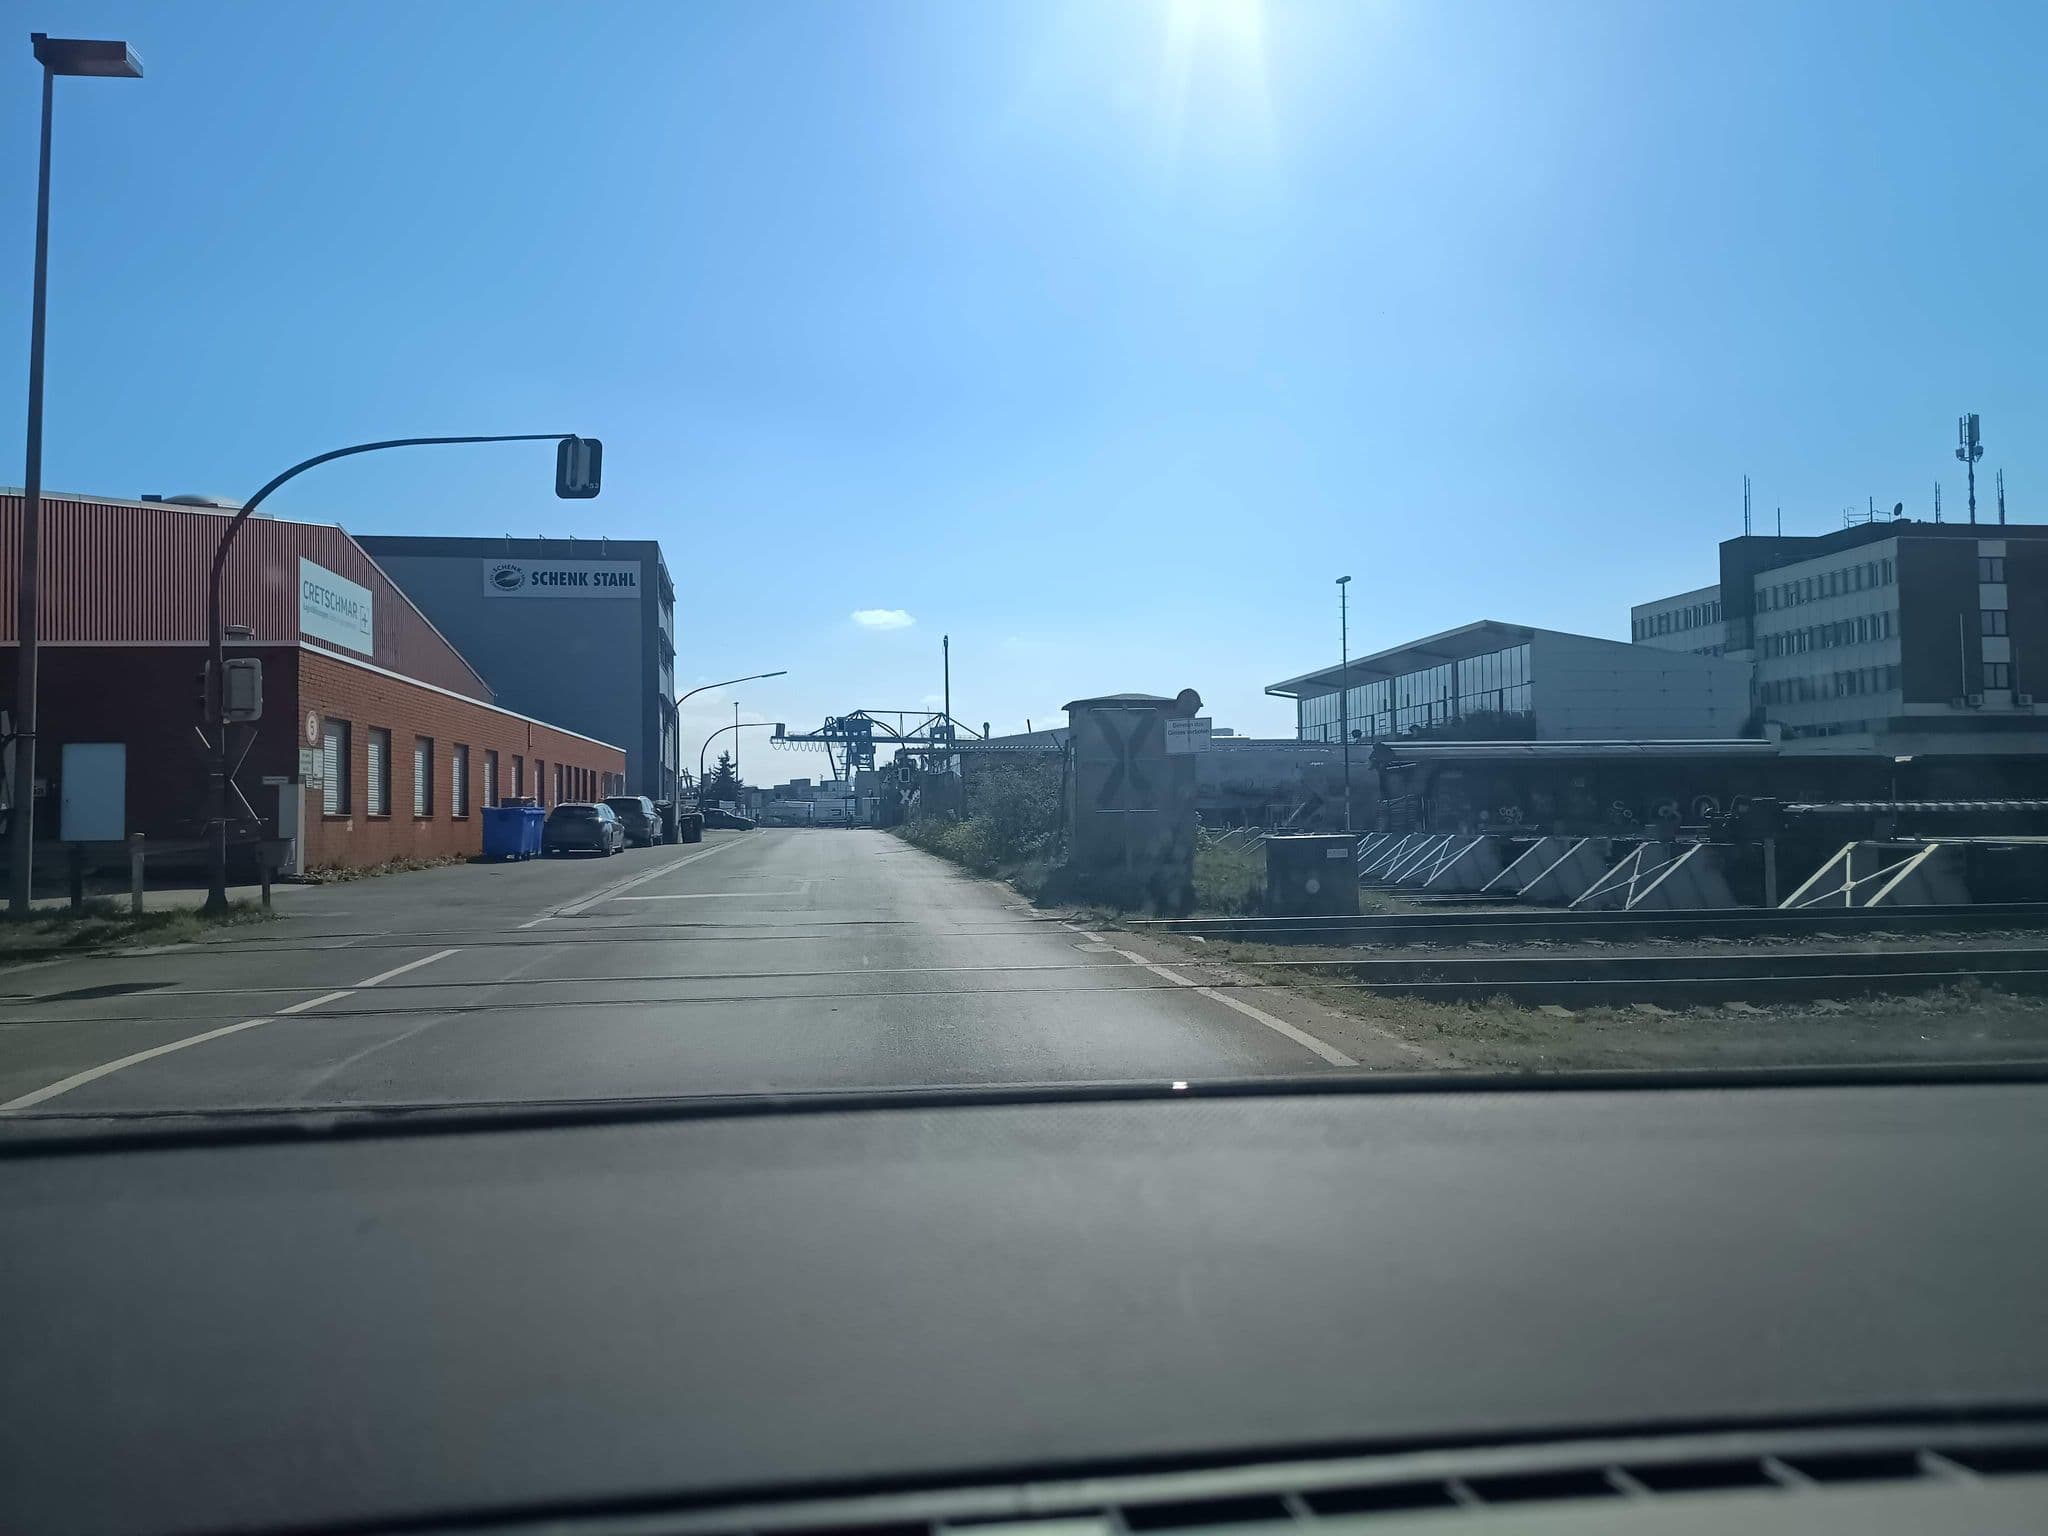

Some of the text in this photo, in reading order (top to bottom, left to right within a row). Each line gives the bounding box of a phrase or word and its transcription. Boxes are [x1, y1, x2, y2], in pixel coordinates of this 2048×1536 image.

[531, 571, 589, 586] SCHENK
[593, 572, 636, 587] STAHL
[303, 580, 358, 619] CRETSCHMAR
